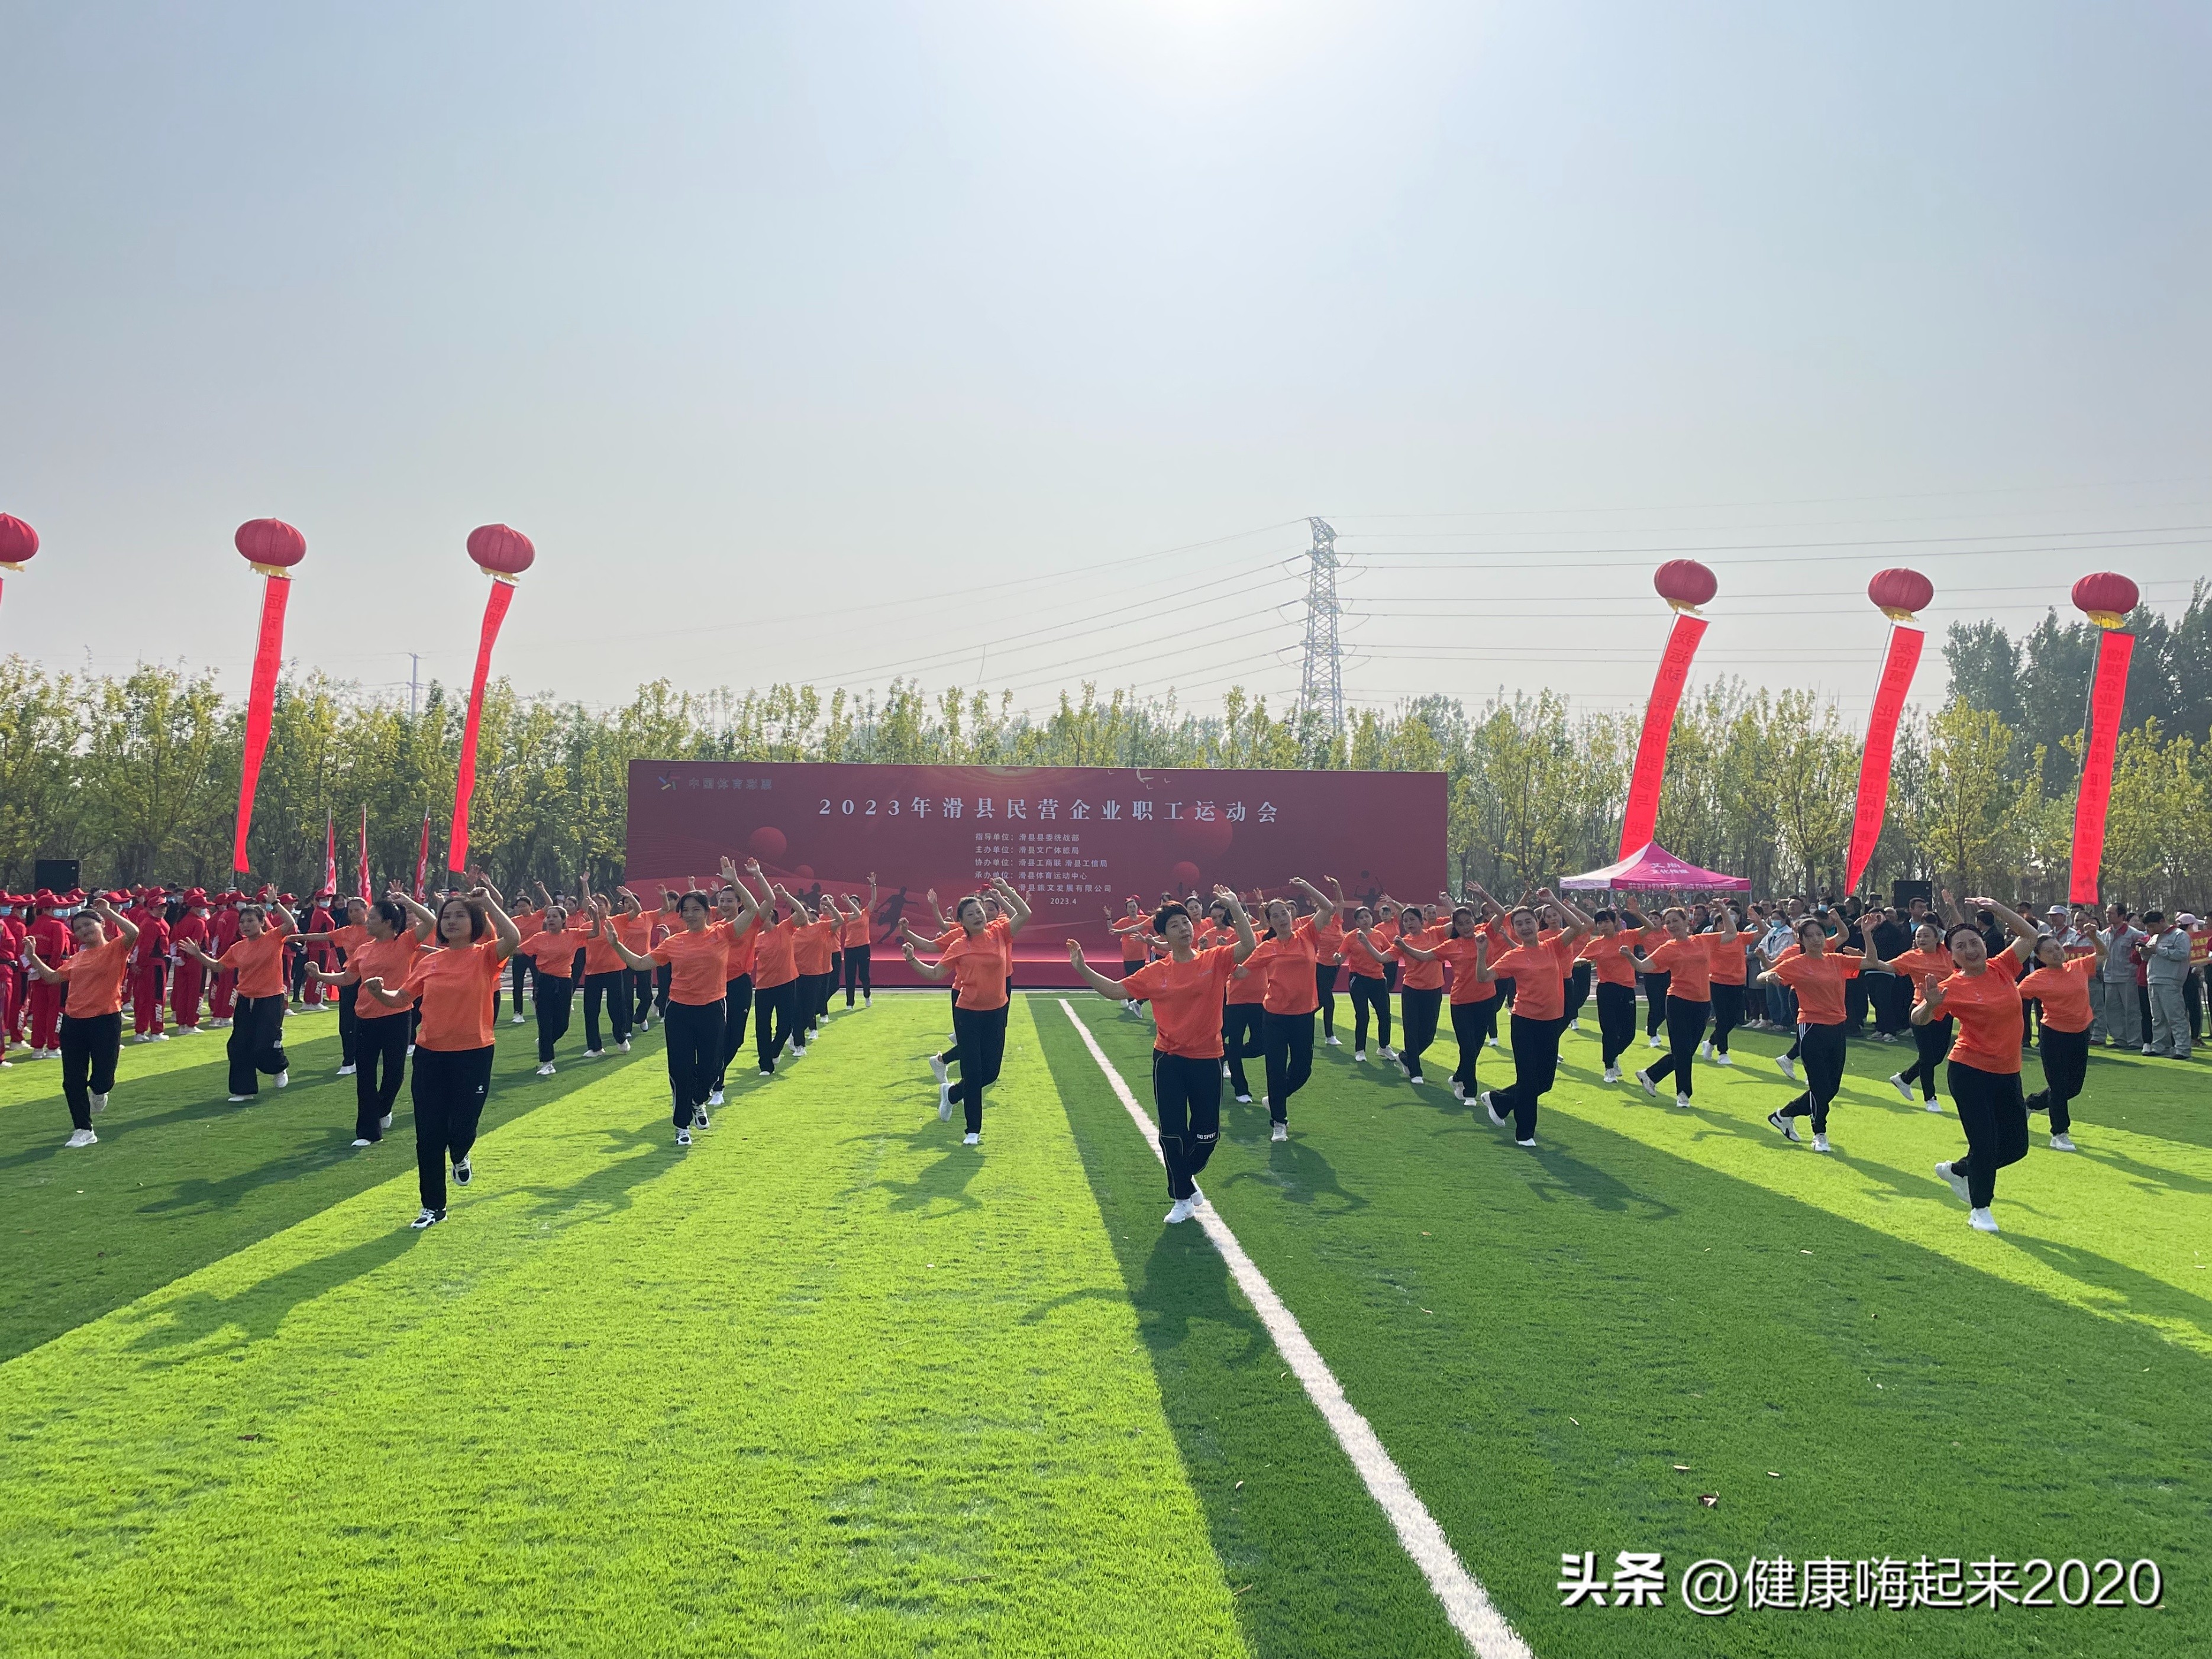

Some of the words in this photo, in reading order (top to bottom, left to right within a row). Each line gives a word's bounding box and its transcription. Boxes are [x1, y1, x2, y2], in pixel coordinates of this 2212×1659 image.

[689, 777, 772, 790] 中国体育彩票
[819, 796, 1278, 823] 2023年滑县民营企业职工运动会
[1065, 860, 1108, 868] 滑县工信局
[1018, 883, 1112, 893] 滑县旅文发展有限公司
